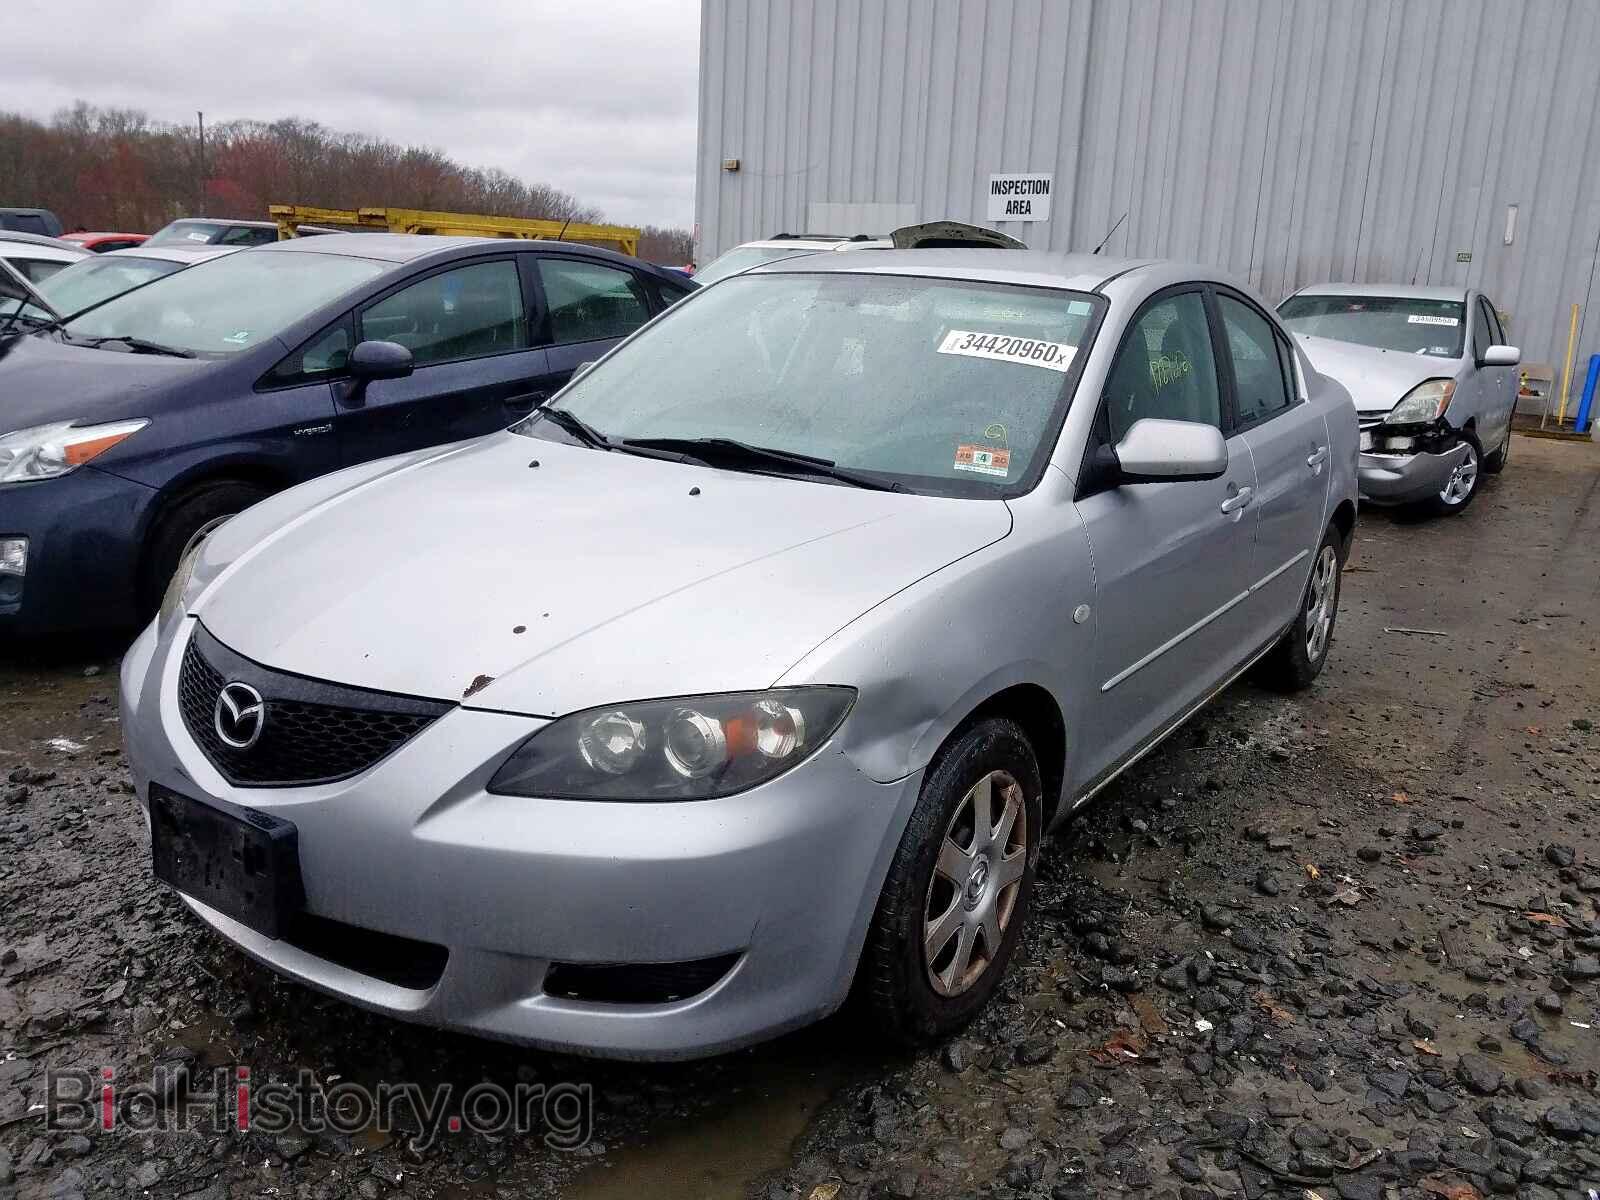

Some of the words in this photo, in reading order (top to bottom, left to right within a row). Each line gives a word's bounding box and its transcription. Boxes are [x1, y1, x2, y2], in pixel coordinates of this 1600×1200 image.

[991, 179, 1050, 195] INSPECTION
[1005, 199, 1032, 215] AREA
[979, 453, 987, 463] 4
